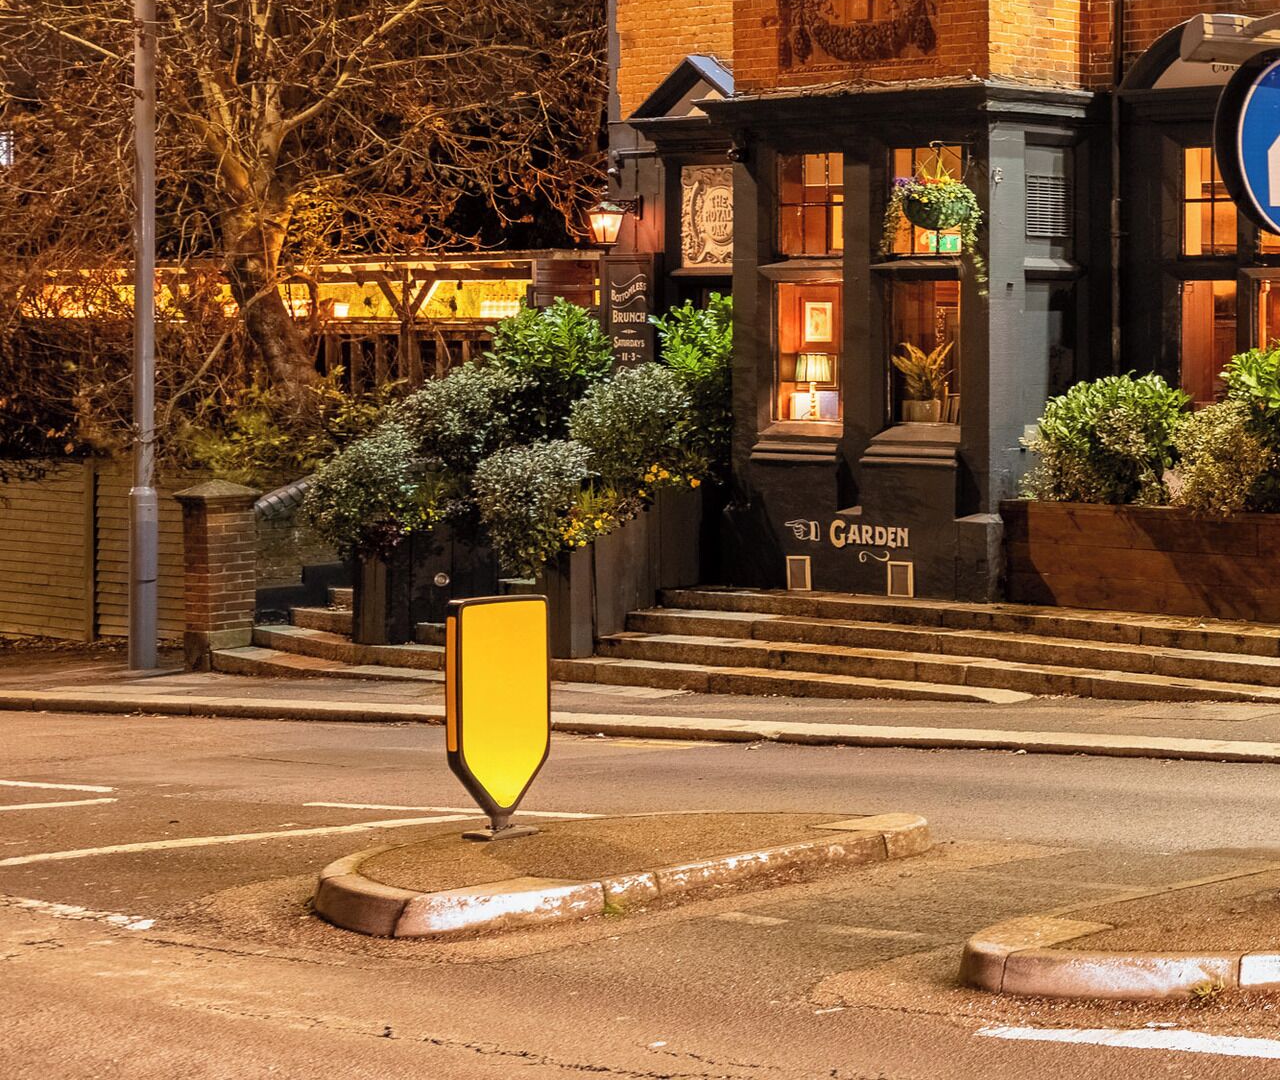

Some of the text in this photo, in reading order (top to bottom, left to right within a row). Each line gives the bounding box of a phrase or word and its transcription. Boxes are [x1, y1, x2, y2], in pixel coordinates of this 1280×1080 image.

[711, 195, 729, 209] THE
[611, 281, 647, 302] BOTTOMLESS
[612, 309, 646, 323] BRUNCH
[829, 519, 909, 549] GARDEN
